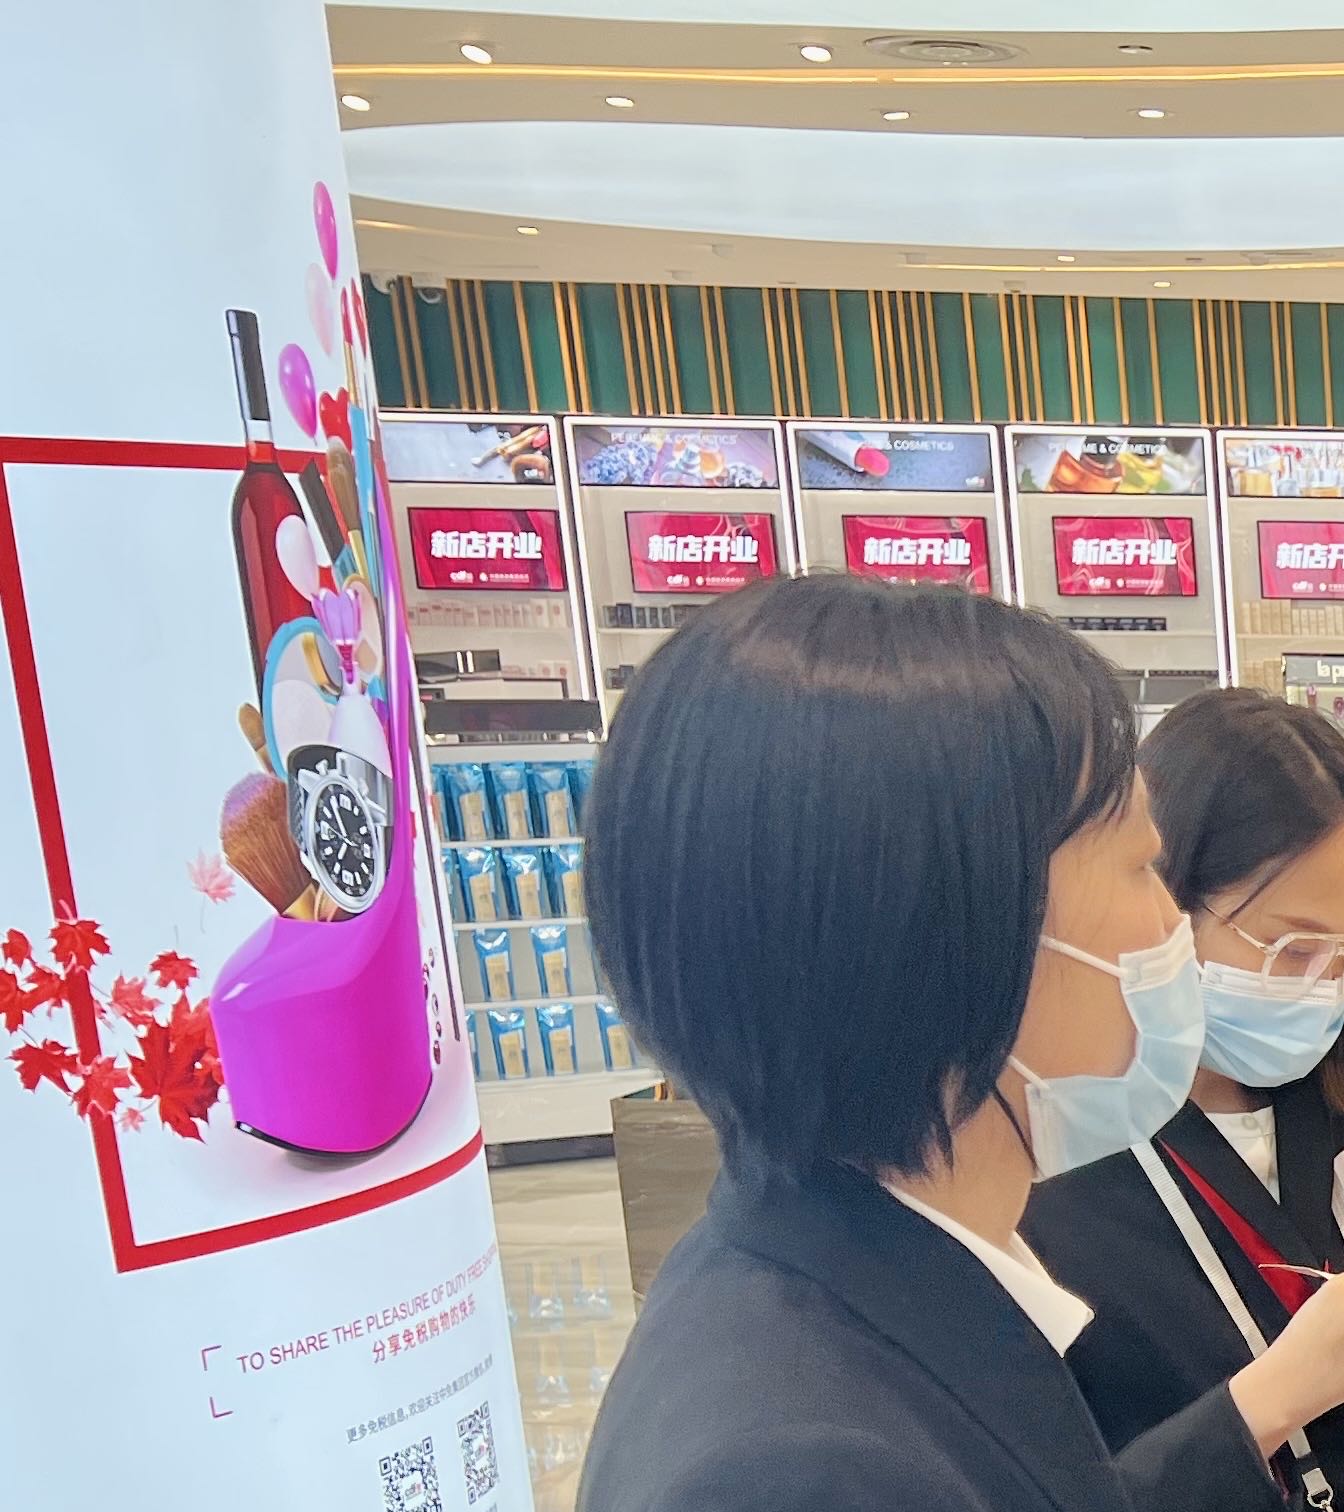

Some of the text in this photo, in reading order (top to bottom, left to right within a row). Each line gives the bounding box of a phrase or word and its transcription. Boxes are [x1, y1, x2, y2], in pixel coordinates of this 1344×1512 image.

[431, 530, 542, 559] 新店开业
[648, 534, 758, 563] 新店开业
[863, 537, 970, 566] 新店开业
[1071, 537, 1177, 566] 新店开业
[1317, 659, 1330, 678] la
[236, 1351, 265, 1373] TO
[270, 1331, 330, 1365] SHARE
[331, 1319, 365, 1345] THE
[366, 1294, 431, 1334] PLEASURE
[431, 1284, 445, 1305] OF
[445, 1270, 467, 1298] DUTY
[372, 1292, 477, 1364] 分享免税购物的快乐
